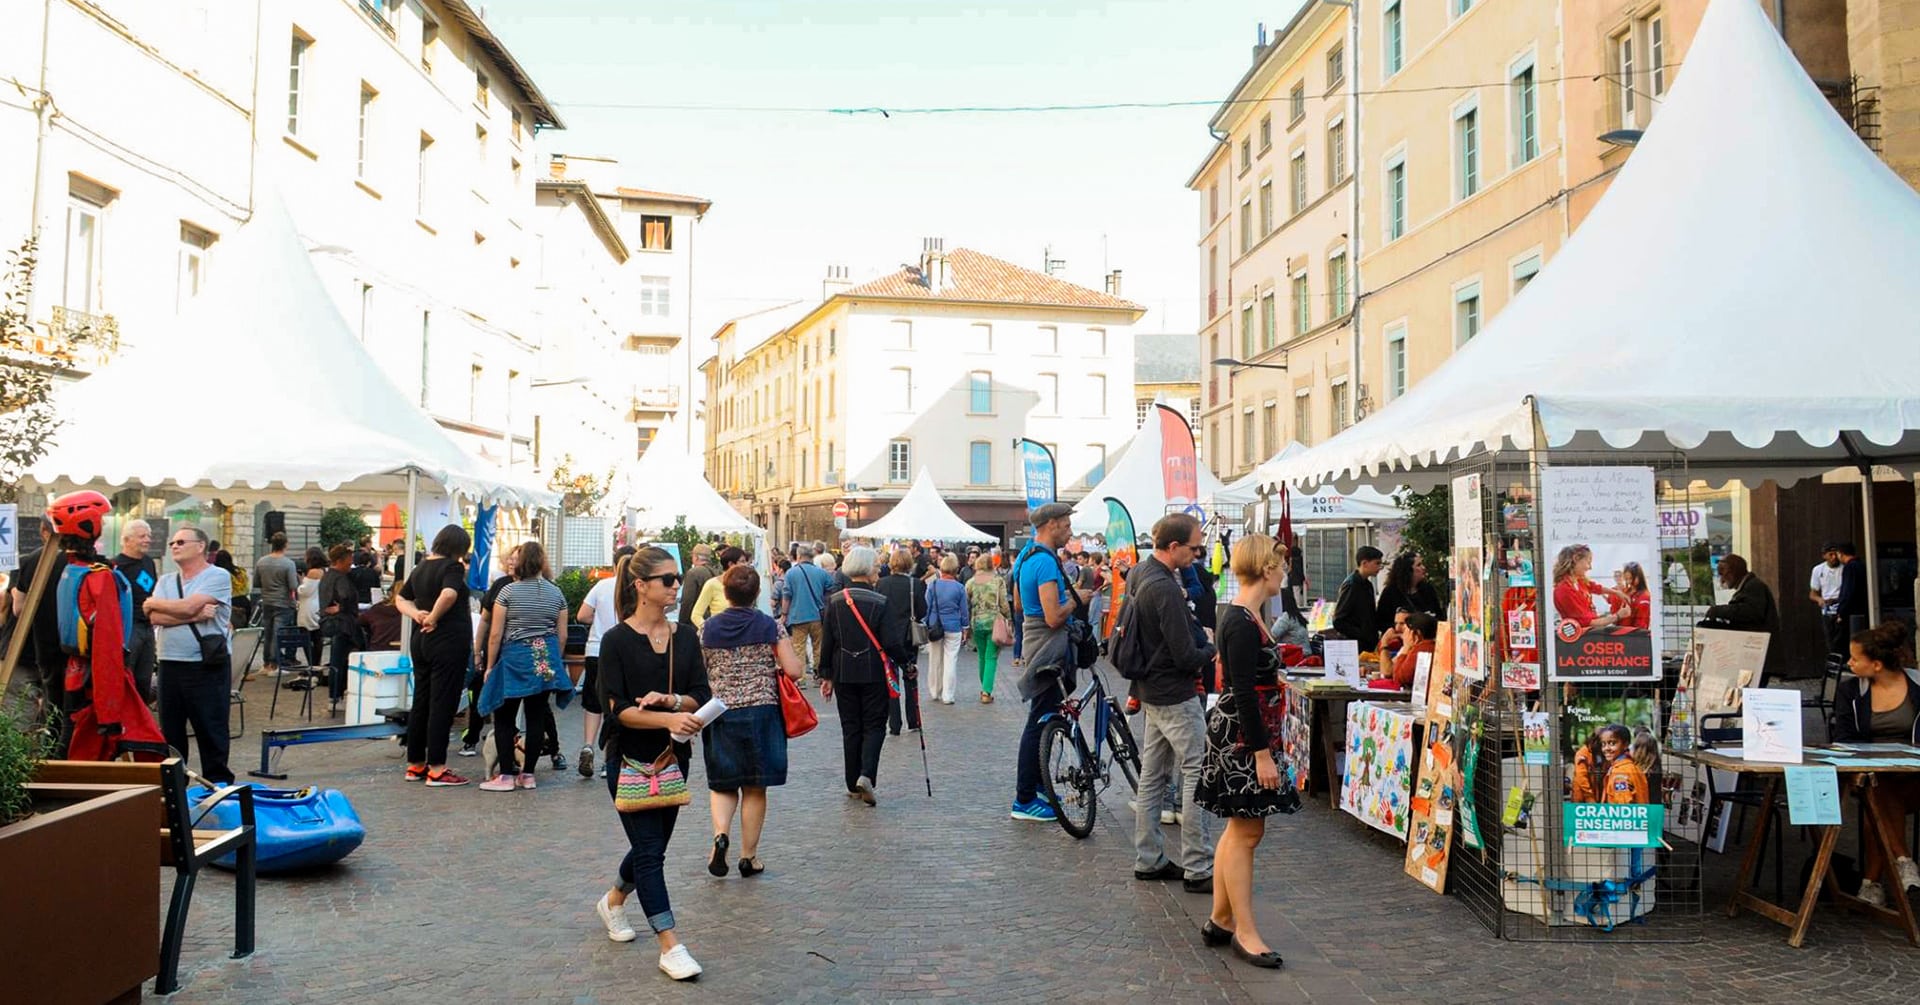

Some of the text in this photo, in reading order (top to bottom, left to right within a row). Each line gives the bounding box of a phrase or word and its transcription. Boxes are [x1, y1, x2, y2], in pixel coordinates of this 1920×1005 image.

[1312, 505, 1334, 513] ANS
[1583, 642, 1625, 655] OSER
[1559, 655, 1650, 668] LA CONFIANCE
[1575, 805, 1648, 818] GRANDIR
[1575, 818, 1648, 830] ENSEMBLE
